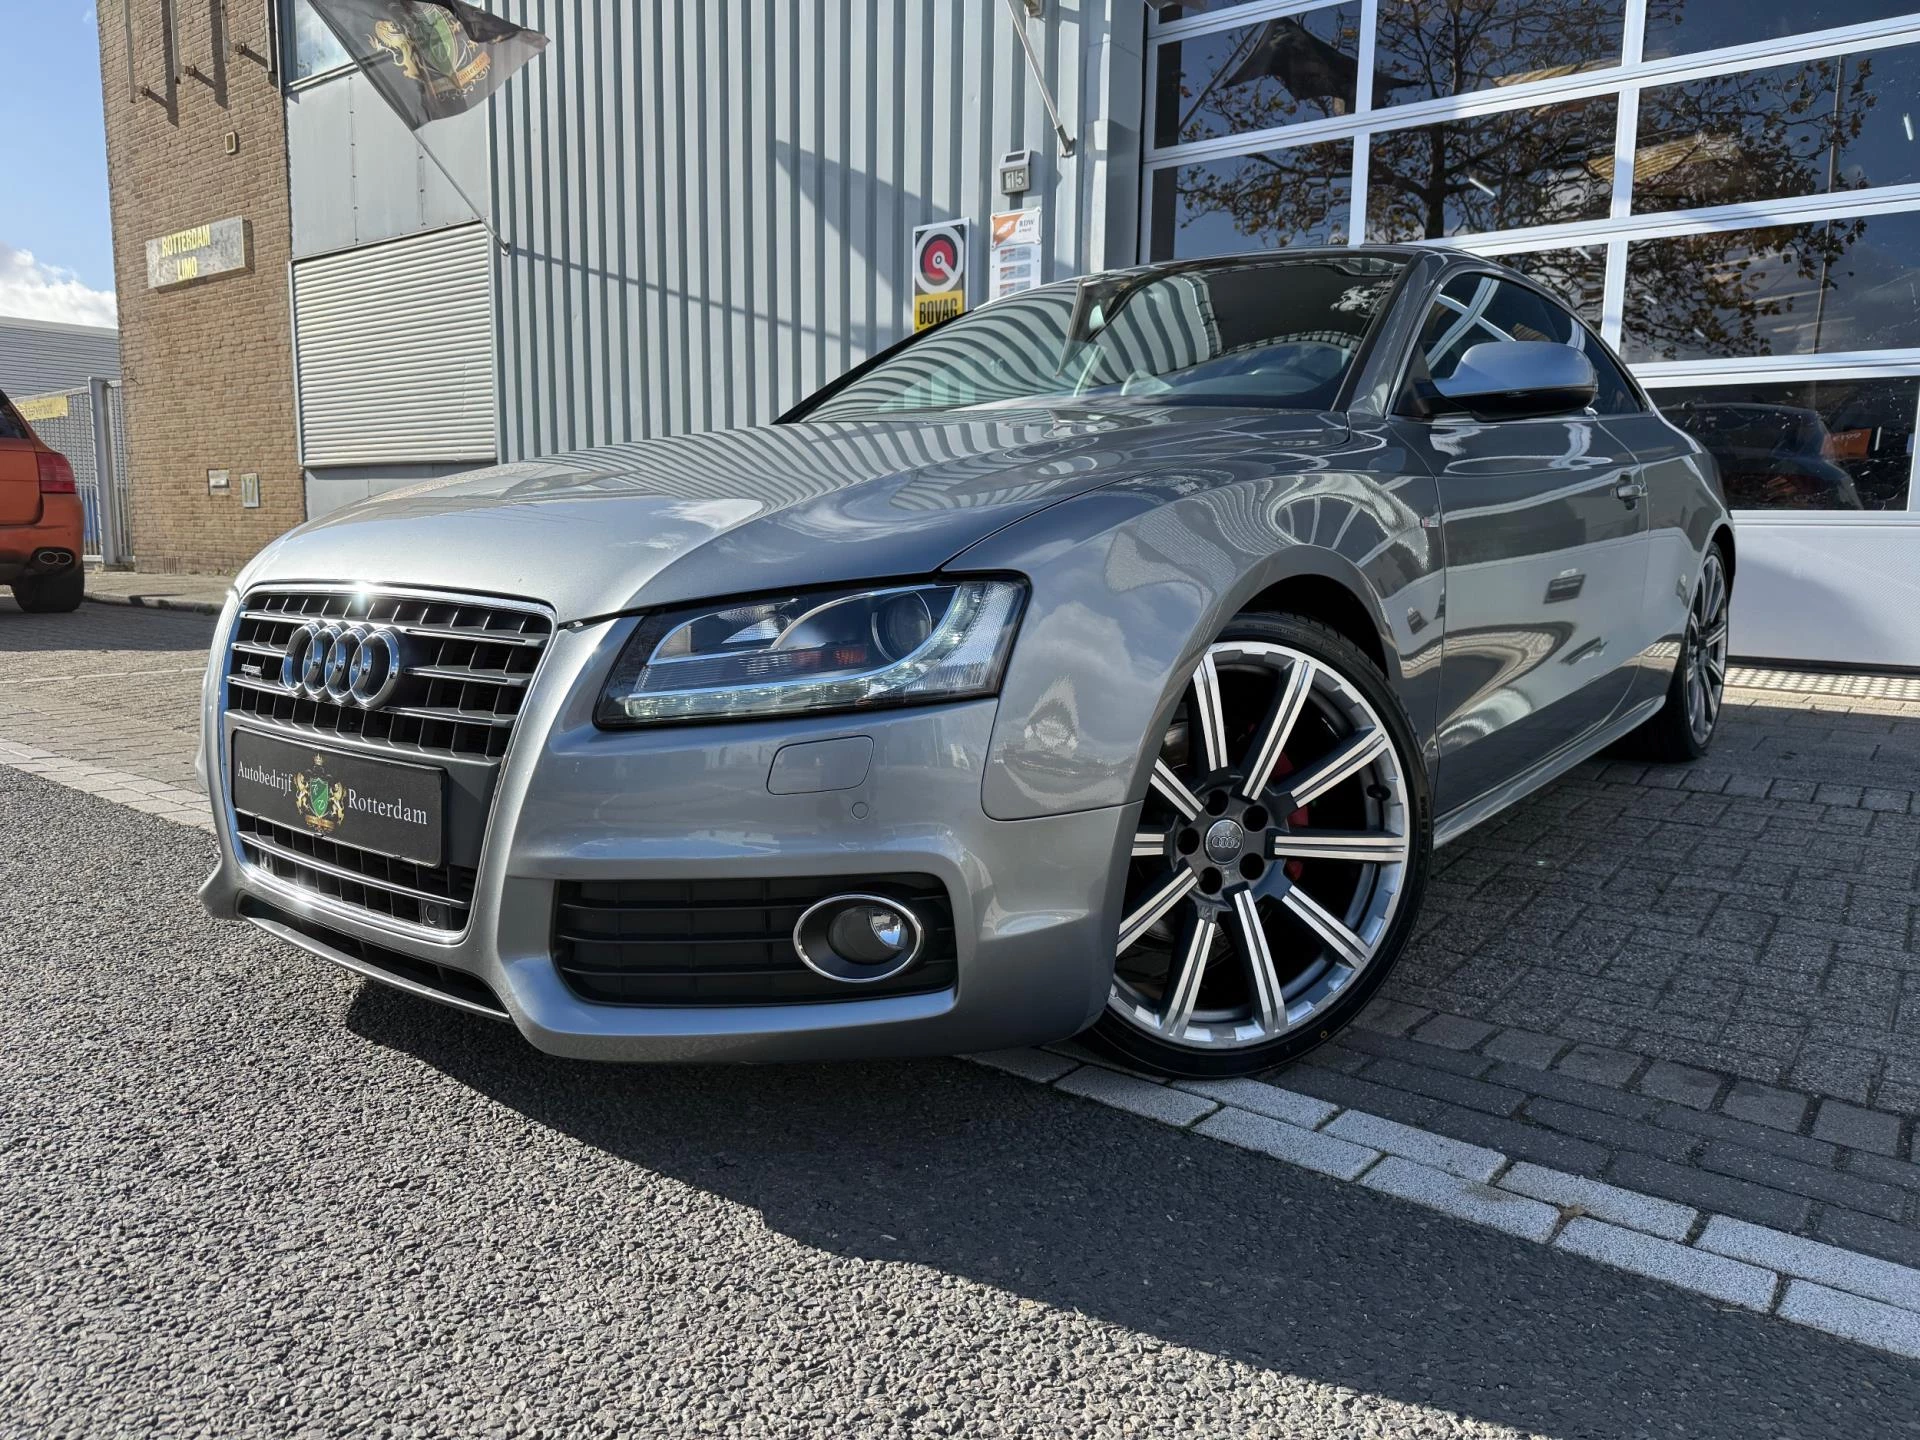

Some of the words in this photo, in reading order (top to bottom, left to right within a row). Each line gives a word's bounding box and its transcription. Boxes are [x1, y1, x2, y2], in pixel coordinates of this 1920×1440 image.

[1007, 171, 1024, 189] 15
[161, 224, 211, 258] ROTTERDAM
[176, 256, 198, 281] LIMO
[919, 297, 958, 325] BOVAG
[238, 760, 294, 797] Autobedrijf
[347, 788, 428, 825] Rotterdam
